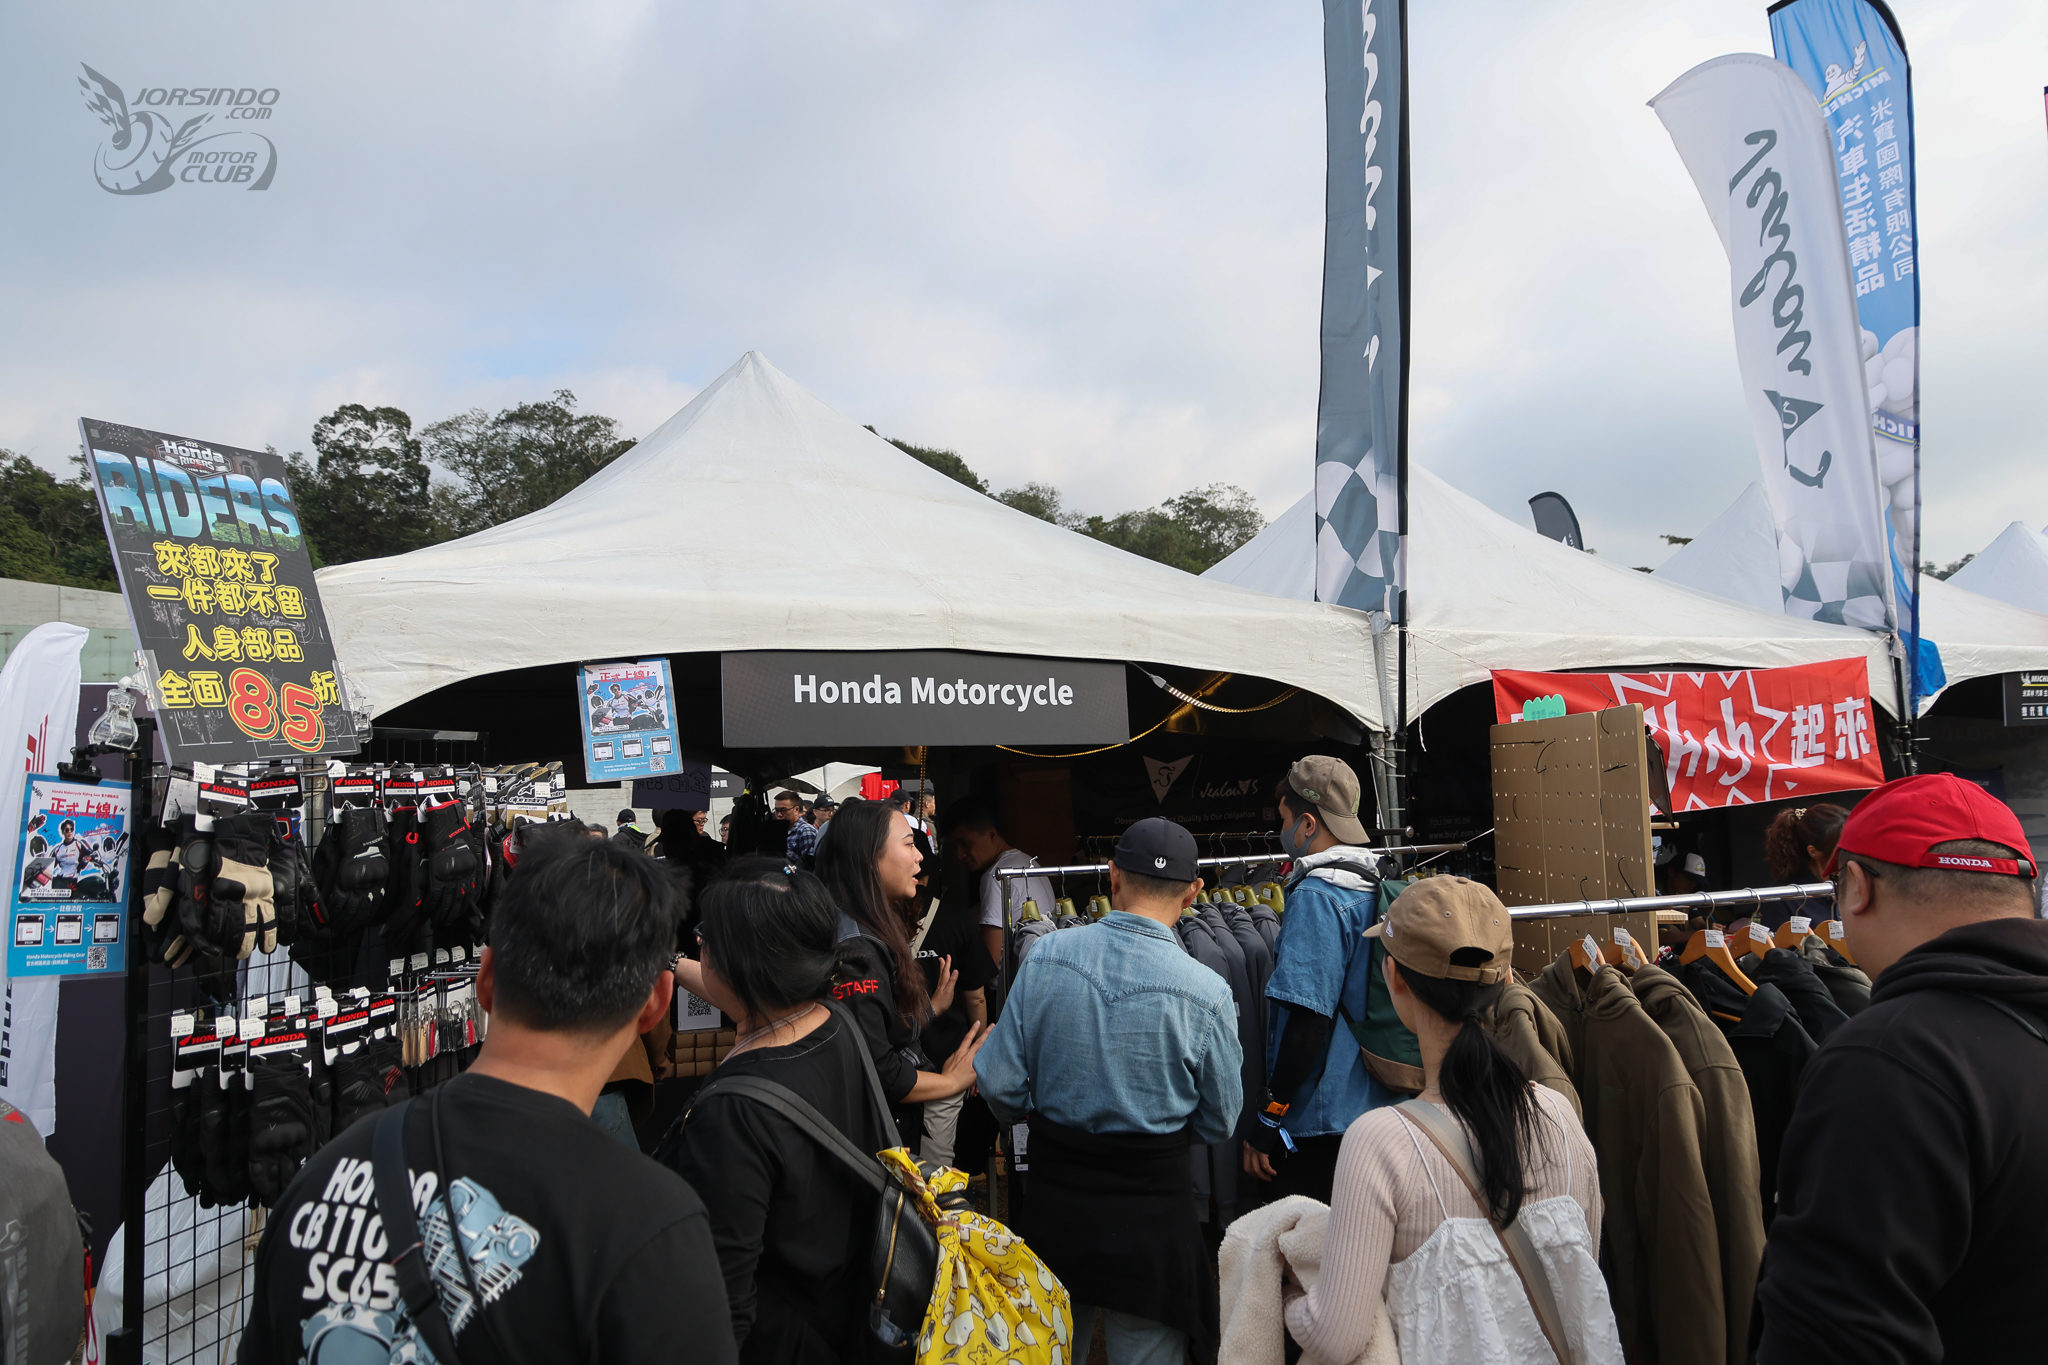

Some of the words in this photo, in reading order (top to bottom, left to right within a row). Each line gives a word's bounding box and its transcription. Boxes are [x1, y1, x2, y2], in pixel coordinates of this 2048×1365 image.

[161, 439, 225, 464] Honda
[179, 455, 215, 470] RIDERS
[93, 449, 302, 551] RIDERS
[153, 540, 279, 585] 來都來了
[147, 577, 307, 620] 一件都不留
[182, 624, 304, 663] 人身部品
[793, 674, 901, 704] Honda
[911, 677, 1074, 712] Motorcycle
[1790, 696, 1871, 768] 起來
[212, 784, 247, 797] HONDA
[251, 778, 297, 790] HONDA
[344, 778, 373, 786] HONDA
[48, 797, 118, 820] 正式上線!
[1177, 814, 1203, 824] Quality
[1210, 813, 1222, 821] Our
[1223, 811, 1256, 821] Obligation
[1938, 856, 1992, 868] HONDA
[832, 979, 879, 1000] STAFF
[370, 998, 395, 1010] HONDA
[337, 1010, 368, 1024] HONDA
[264, 1032, 306, 1045] HONDA
[302, 1251, 401, 1311] SC65
